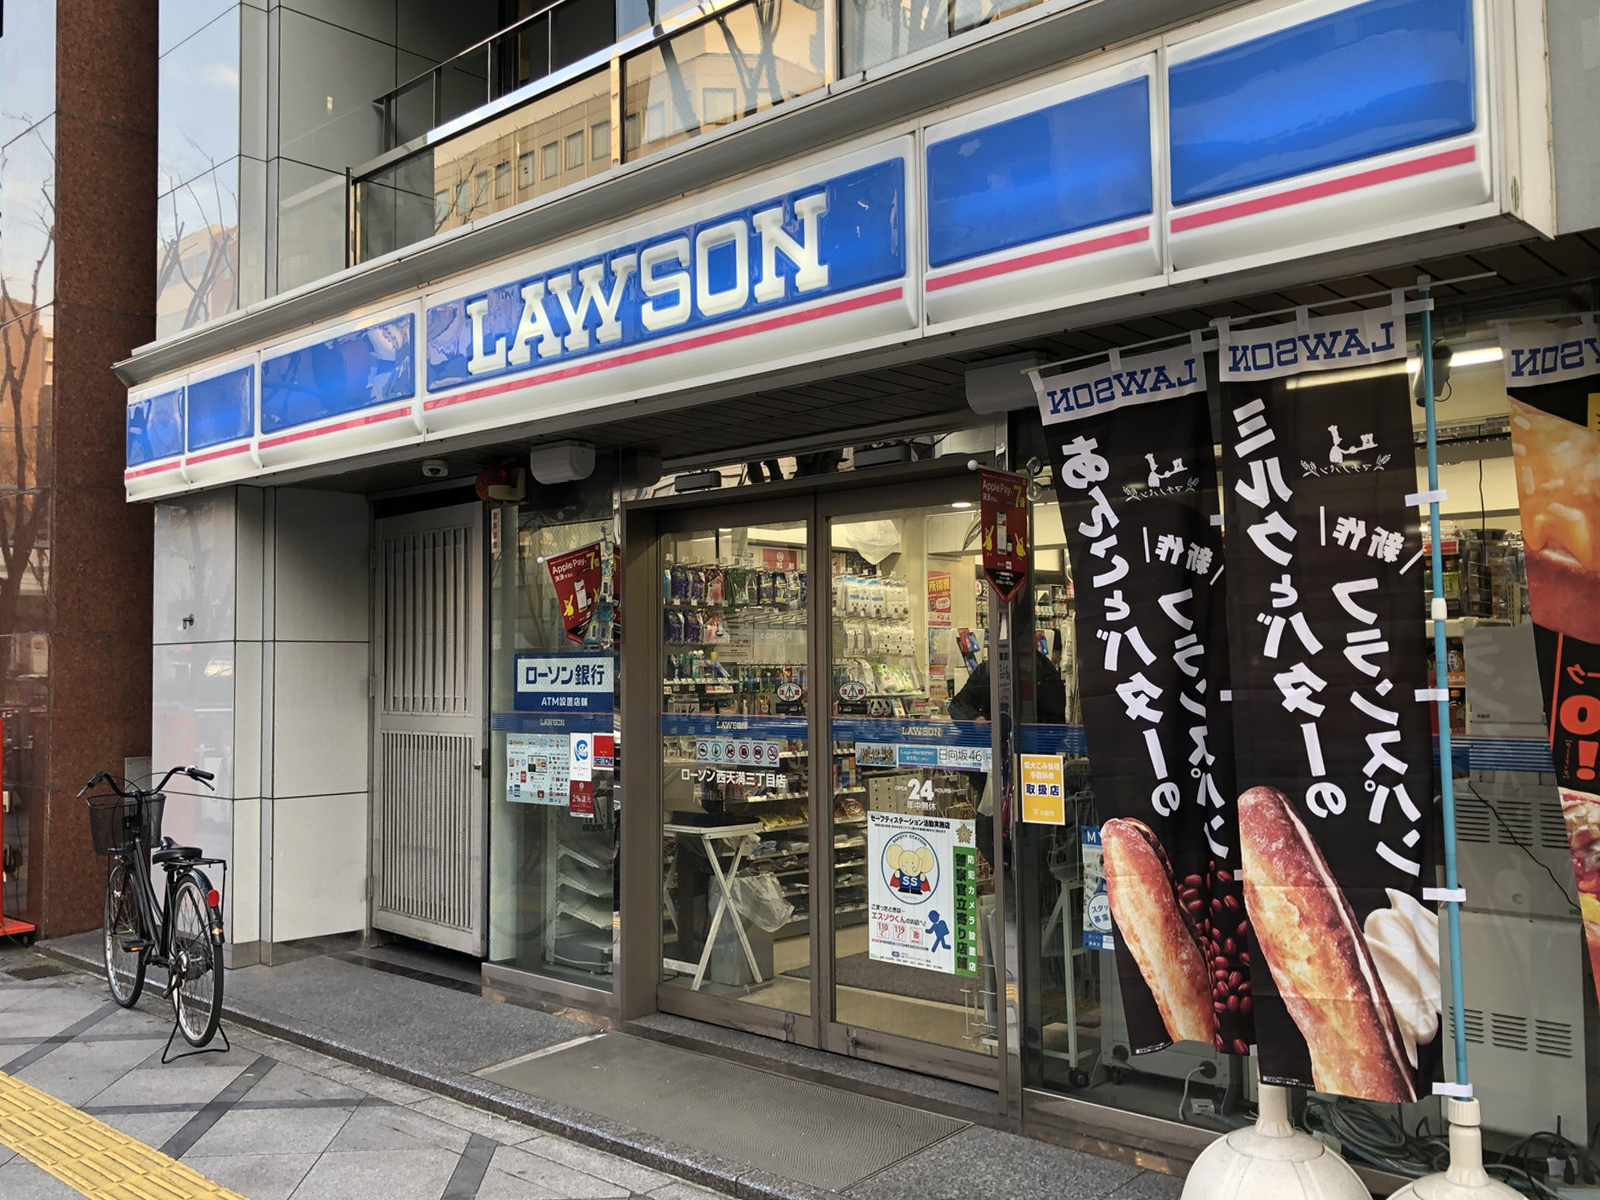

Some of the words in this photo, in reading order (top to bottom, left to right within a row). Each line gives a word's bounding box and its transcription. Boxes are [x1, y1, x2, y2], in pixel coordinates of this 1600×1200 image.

[466, 191, 829, 376] LAWSON
[552, 562, 573, 574] Apple
[525, 664, 605, 686] ローソン銀行
[541, 697, 588, 707] ATM設置店舗
[901, 726, 942, 737] LAWSON
[939, 748, 982, 762] 日向坂46
[681, 768, 787, 789] ローソン西天満三丁目店
[907, 778, 935, 801] 24
[1026, 783, 1060, 796] 取扱店
[906, 801, 937, 811] 年中無休
[902, 876, 918, 887] SS
[878, 923, 889, 932] 110
[894, 925, 905, 934] 119
